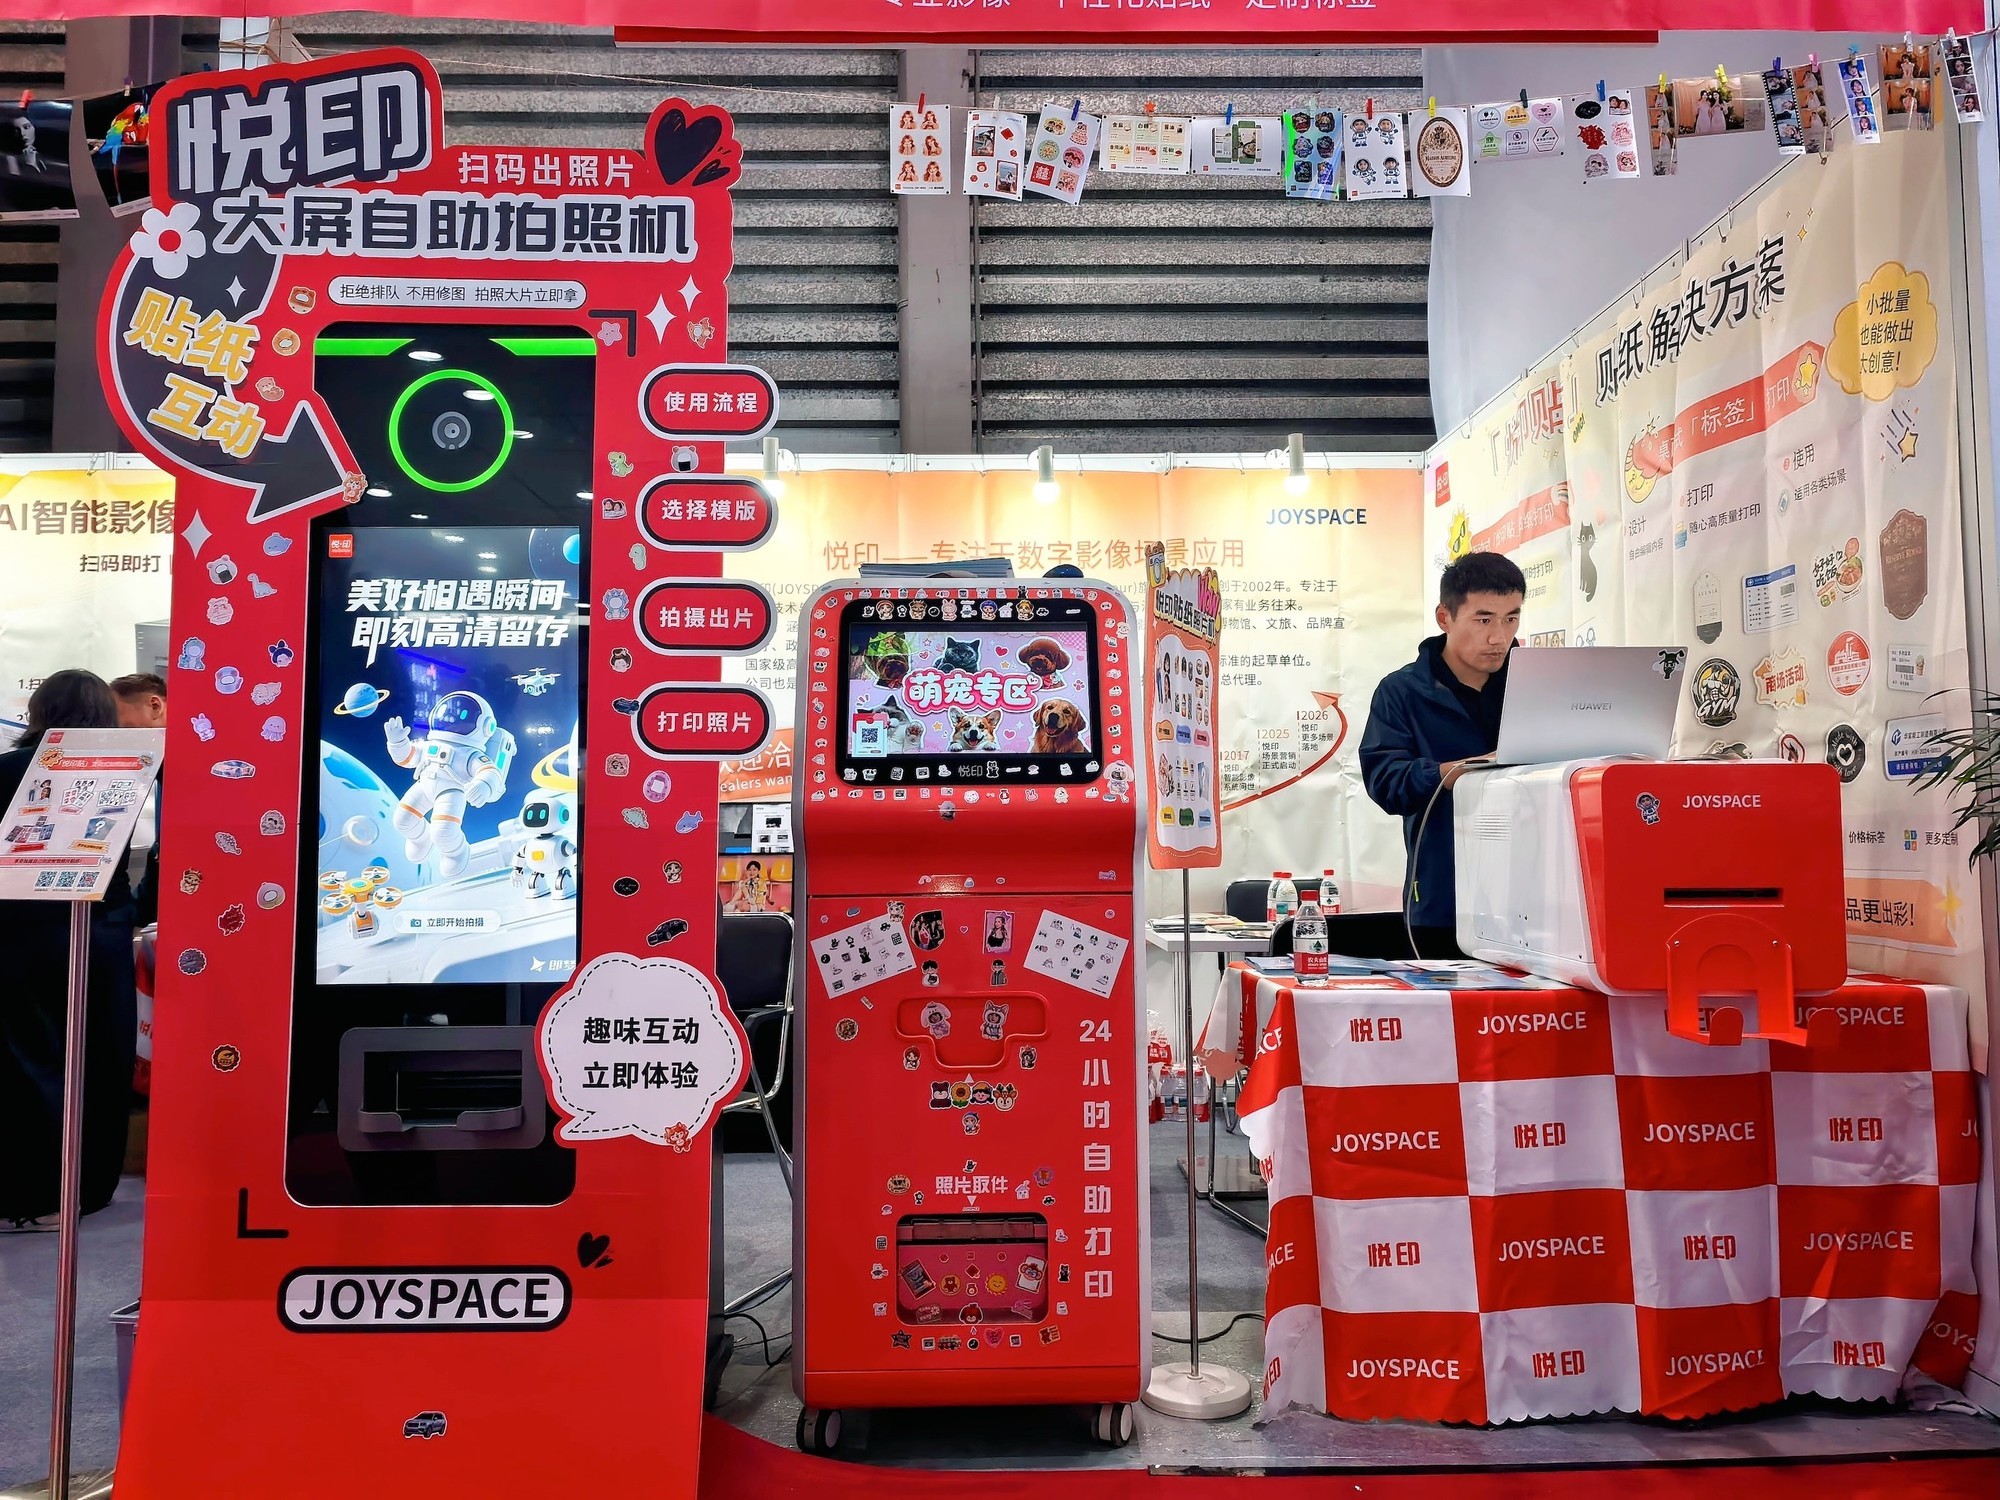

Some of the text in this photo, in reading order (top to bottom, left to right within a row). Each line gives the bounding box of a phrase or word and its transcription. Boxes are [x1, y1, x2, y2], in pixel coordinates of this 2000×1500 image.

[176, 70, 420, 195] 悦印
[457, 151, 635, 188] 扫码出照片
[221, 194, 690, 255] 大屏自助拍照机
[340, 284, 578, 303] 拒绝排队 不用修图 拍照大片立即拿
[1866, 289, 1911, 316] 小批量
[124, 286, 260, 384] 贴纸
[1859, 318, 1914, 347] 也能做出
[1858, 350, 1902, 375] 大创意!
[663, 391, 759, 414] 使用流程
[149, 373, 266, 457] 互动
[1792, 443, 1815, 470] 使用
[1686, 482, 1714, 507] 打印
[1793, 468, 1848, 501] 适用各类场景
[0, 499, 175, 535] AI智能影像
[661, 500, 756, 522] 选择模版
[1266, 508, 1368, 525] JOYSPACE
[1688, 503, 1761, 535] 随心高质量打印
[1628, 515, 1647, 537] 设计
[79, 554, 161, 572] 扫码即打
[345, 579, 567, 612] 美好相遇瞬间
[659, 607, 754, 629] 拍摄出片
[351, 616, 572, 669] 即刻高清留存
[1220, 674, 1264, 687] 总代理。
[1764, 662, 1805, 695] 商场活动
[909, 674, 1032, 708] 萌宠专区
[1301, 710, 1329, 721] 2026
[1571, 702, 1612, 711] HUAWEI
[1697, 695, 1736, 717] GYM
[657, 711, 753, 734] 打印照片
[1261, 729, 1290, 739] 2025
[1301, 724, 1319, 732] 悦印
[1261, 742, 1280, 751] 悦印
[1301, 733, 1335, 742] 更多场景
[1301, 743, 1319, 752] 落地
[719, 740, 793, 774] 迎洽
[1224, 750, 1250, 761] 2017
[1261, 752, 1297, 761] 场景营销
[1261, 761, 1297, 770] 正式启动
[958, 764, 984, 778] 悦印
[1223, 764, 1240, 772] 悦印
[719, 775, 793, 793] ealers wan
[1682, 794, 1762, 810] JOYSPACE
[1848, 830, 1886, 845] 价格标签
[1924, 831, 1959, 847] 更多定制
[426, 917, 485, 929] 立即开始拍摄
[1846, 897, 1915, 927] 品更出彩!
[1477, 1011, 1588, 1036] JOYSPACE
[1795, 1006, 1905, 1026] JSPACE
[582, 1016, 700, 1045] 趣味互动
[1350, 1017, 1403, 1043] 悦印
[582, 1061, 699, 1090] 立即体验
[1513, 1121, 1567, 1149] 悦印
[1644, 1121, 1756, 1144] JOYSPACE
[1829, 1116, 1883, 1143] 悦印
[1331, 1131, 1441, 1153] JOYSPACE
[935, 1175, 1009, 1195] 照片取件
[1499, 1235, 1605, 1263] JOYSPACE
[1683, 1234, 1737, 1261] 悦印
[1803, 1230, 1914, 1251] JOYSPACE
[1367, 1241, 1421, 1268] 悦印
[298, 1277, 551, 1321] JOYSPACE
[1532, 1350, 1587, 1379] 悦印
[1833, 1340, 1886, 1368] 悦印
[1347, 1356, 1461, 1381] JOYSPACE
